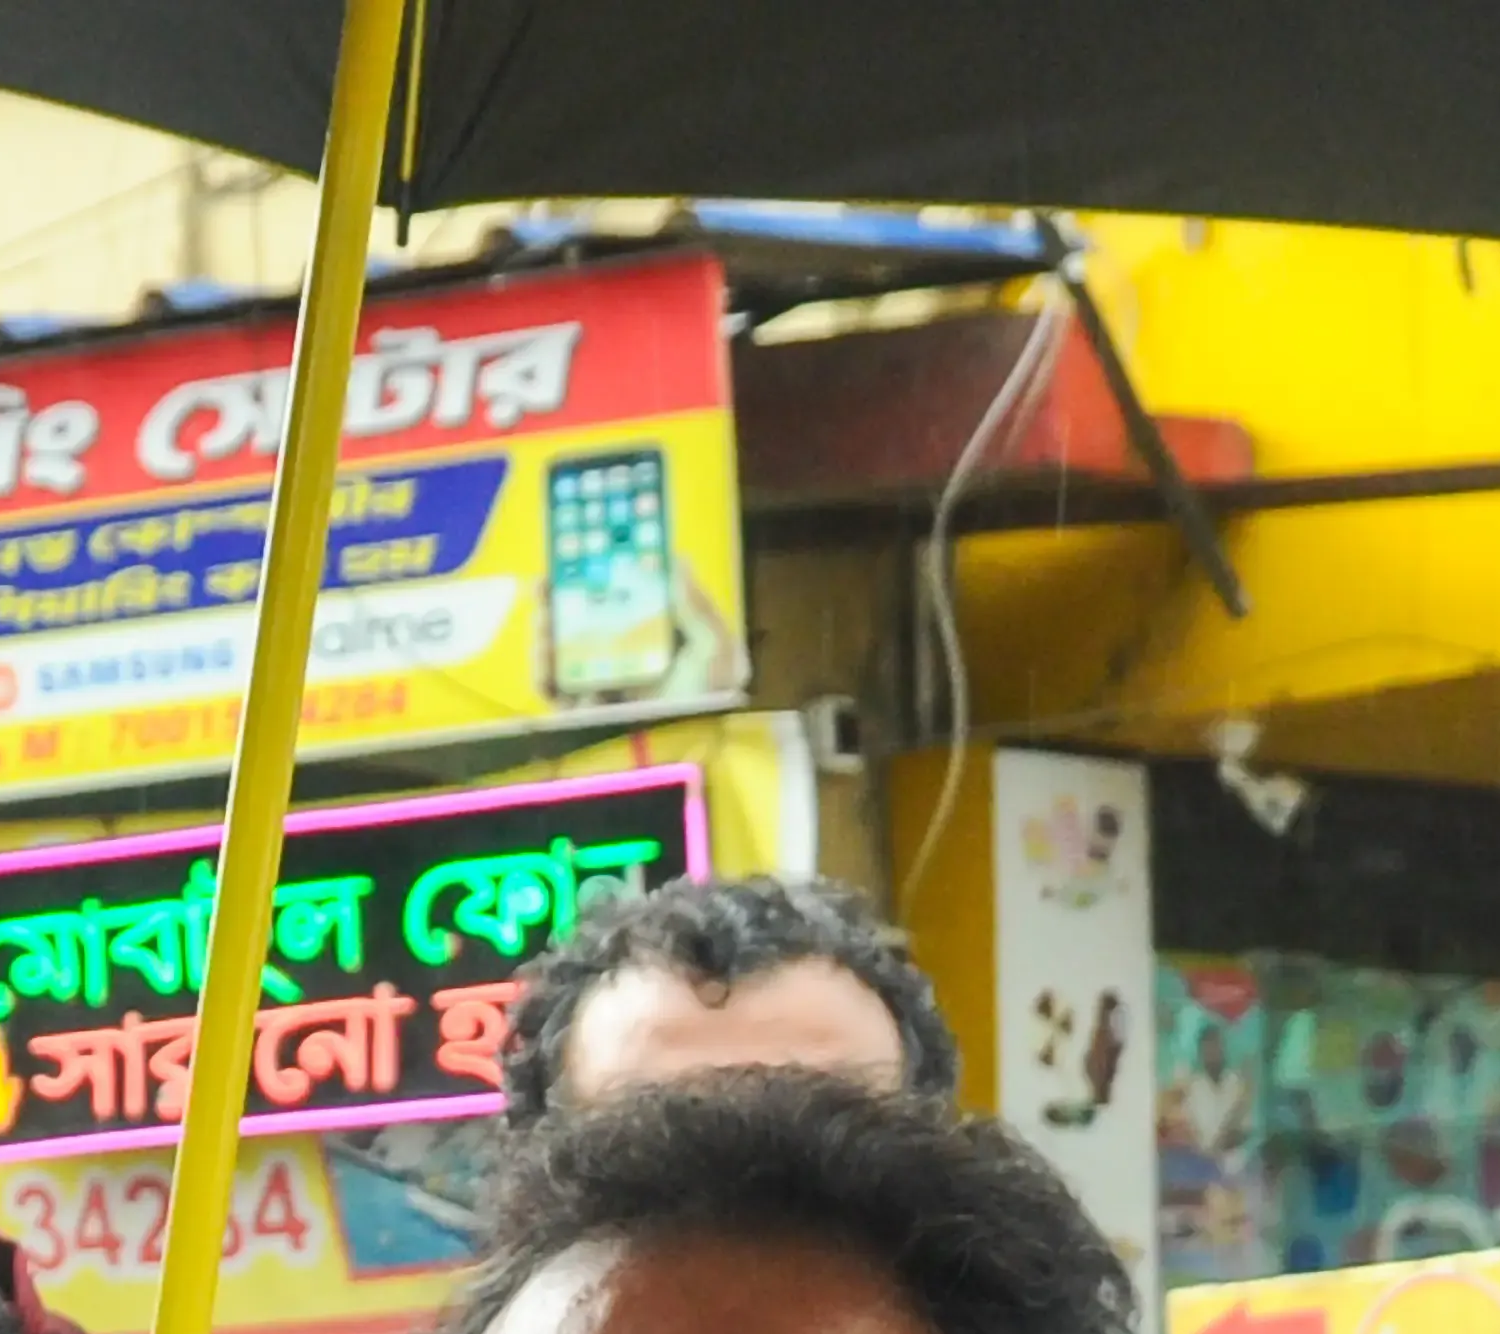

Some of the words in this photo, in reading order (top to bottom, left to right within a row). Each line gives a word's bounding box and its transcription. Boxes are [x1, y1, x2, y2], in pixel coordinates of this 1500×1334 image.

[36, 638, 235, 693] SAMSUNG
[28, 981, 420, 1121] সারনো
[15, 1161, 309, 1270] 3424
